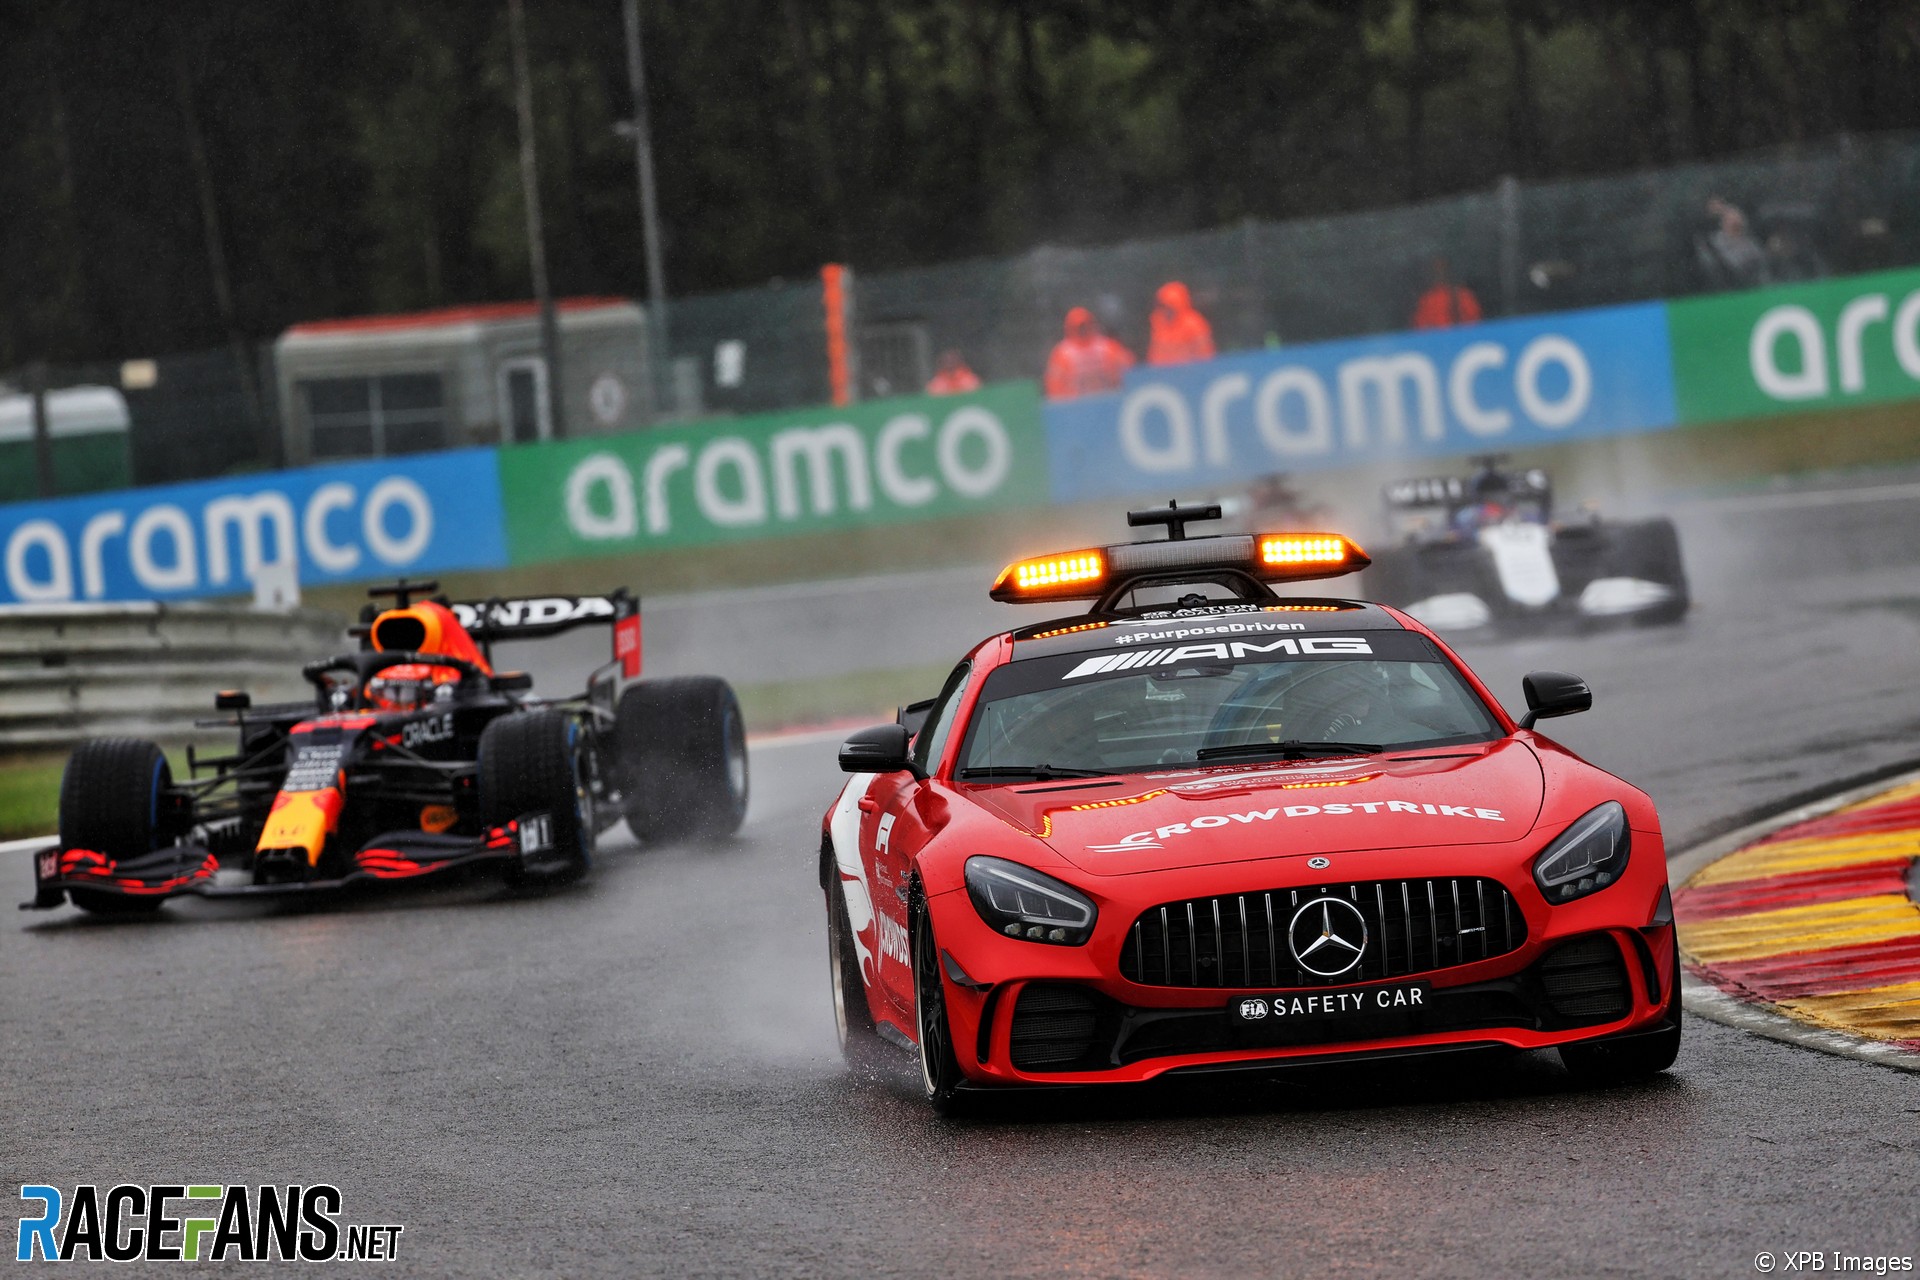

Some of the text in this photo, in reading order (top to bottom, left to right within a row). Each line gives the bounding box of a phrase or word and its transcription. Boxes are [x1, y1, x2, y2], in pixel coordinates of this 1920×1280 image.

[1119, 333, 1592, 473] aramco
[565, 405, 1012, 540] aramco
[5, 477, 433, 601] aramco
[451, 597, 615, 628] ONDA
[1115, 622, 1305, 644] #PurposeDriven
[402, 713, 454, 748] ORACLE
[1119, 800, 1506, 847] CROWDSTRIKE
[1274, 992, 1364, 1016] SAFETY
[1376, 987, 1423, 1007] CAR
